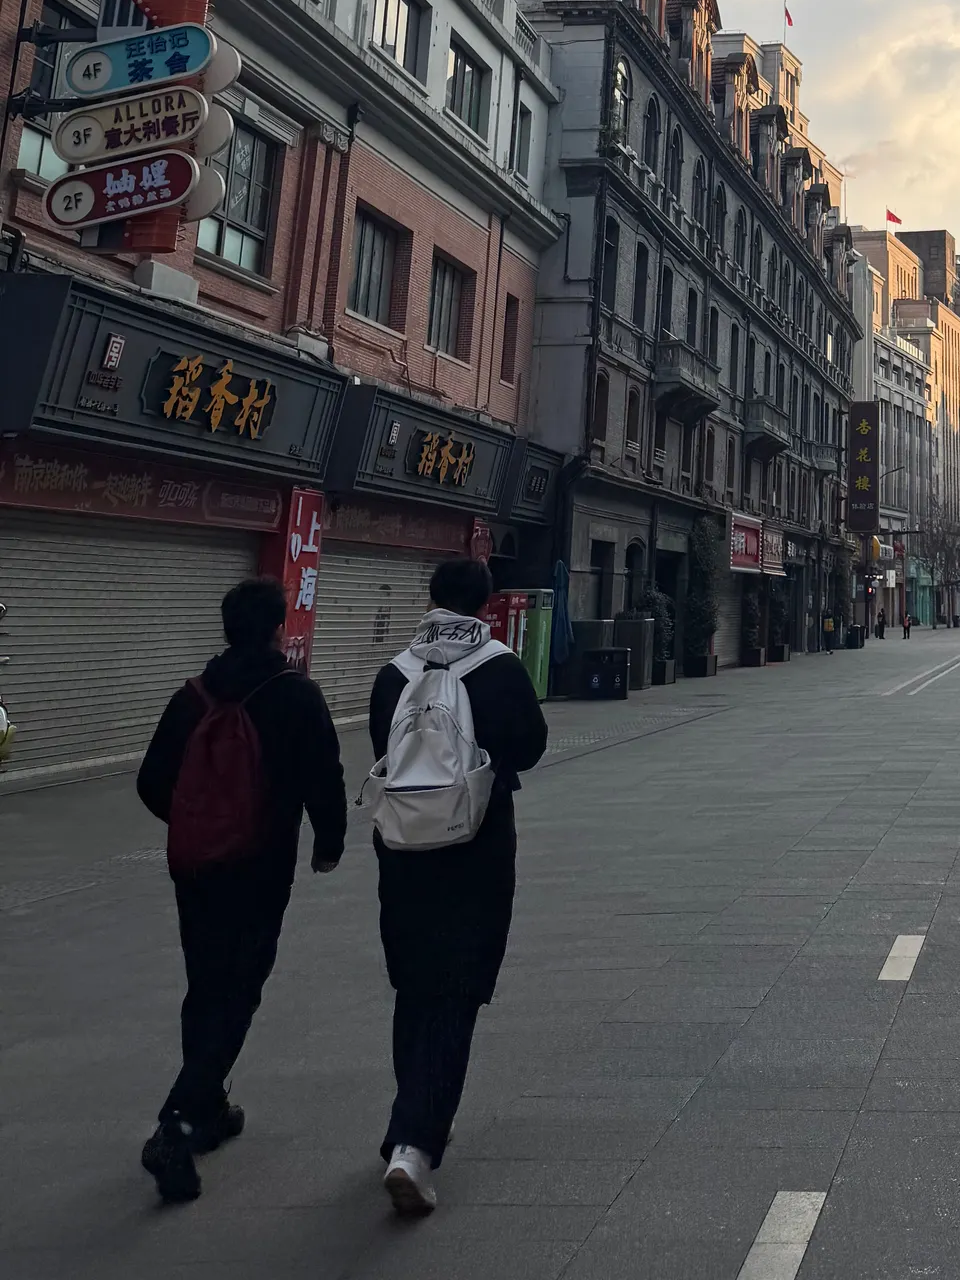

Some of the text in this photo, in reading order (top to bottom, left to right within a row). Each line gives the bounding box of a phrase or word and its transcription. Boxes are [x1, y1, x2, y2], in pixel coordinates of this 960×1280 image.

[124, 30, 190, 59] 汪怡记
[82, 62, 102, 80] 4F
[128, 51, 190, 84] 茶舍
[113, 91, 187, 124] ALLORA
[72, 127, 93, 145] 3F
[104, 110, 200, 150] 意大利餐厅
[63, 192, 84, 211] 2F
[162, 354, 271, 440] 稻香村
[416, 429, 476, 487] 稻香村
[294, 510, 321, 612] 上海
